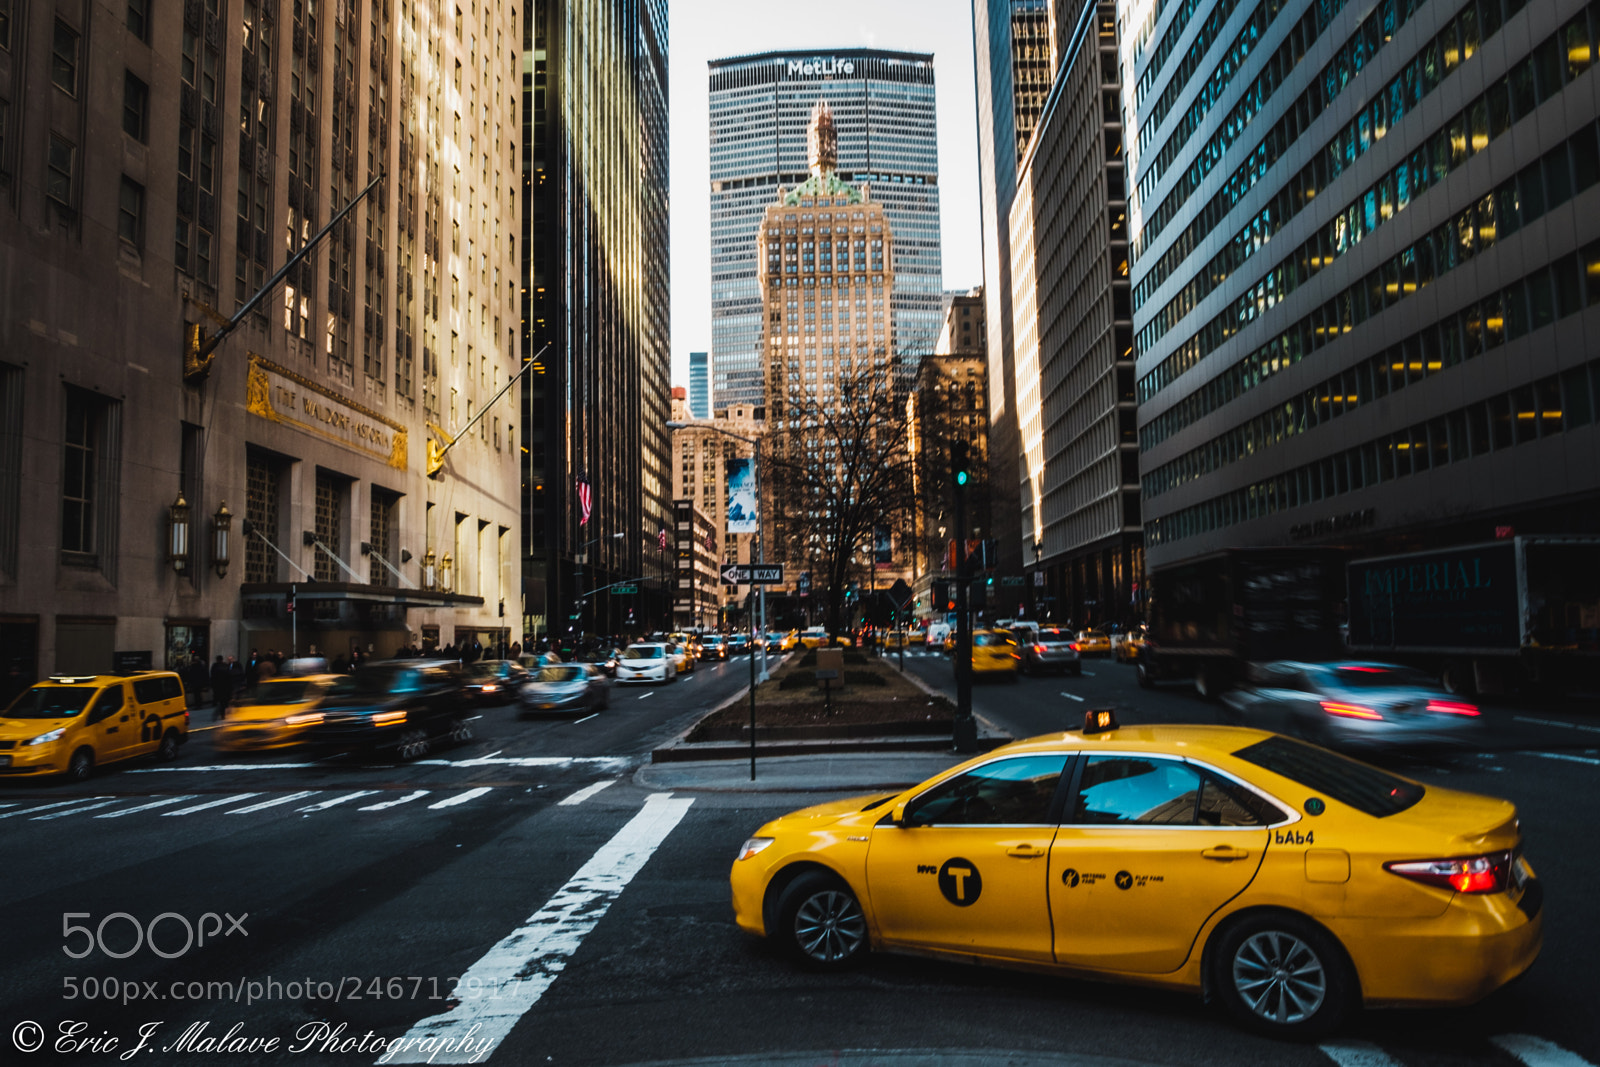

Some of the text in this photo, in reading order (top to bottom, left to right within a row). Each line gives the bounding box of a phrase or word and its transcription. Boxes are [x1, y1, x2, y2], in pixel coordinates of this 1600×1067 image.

[788, 56, 855, 76] MetLife
[275, 385, 297, 410] THE
[728, 569, 778, 579] ONE WAY
[1365, 557, 1492, 595] IMPERIAL
[917, 864, 972, 901] NYC T
